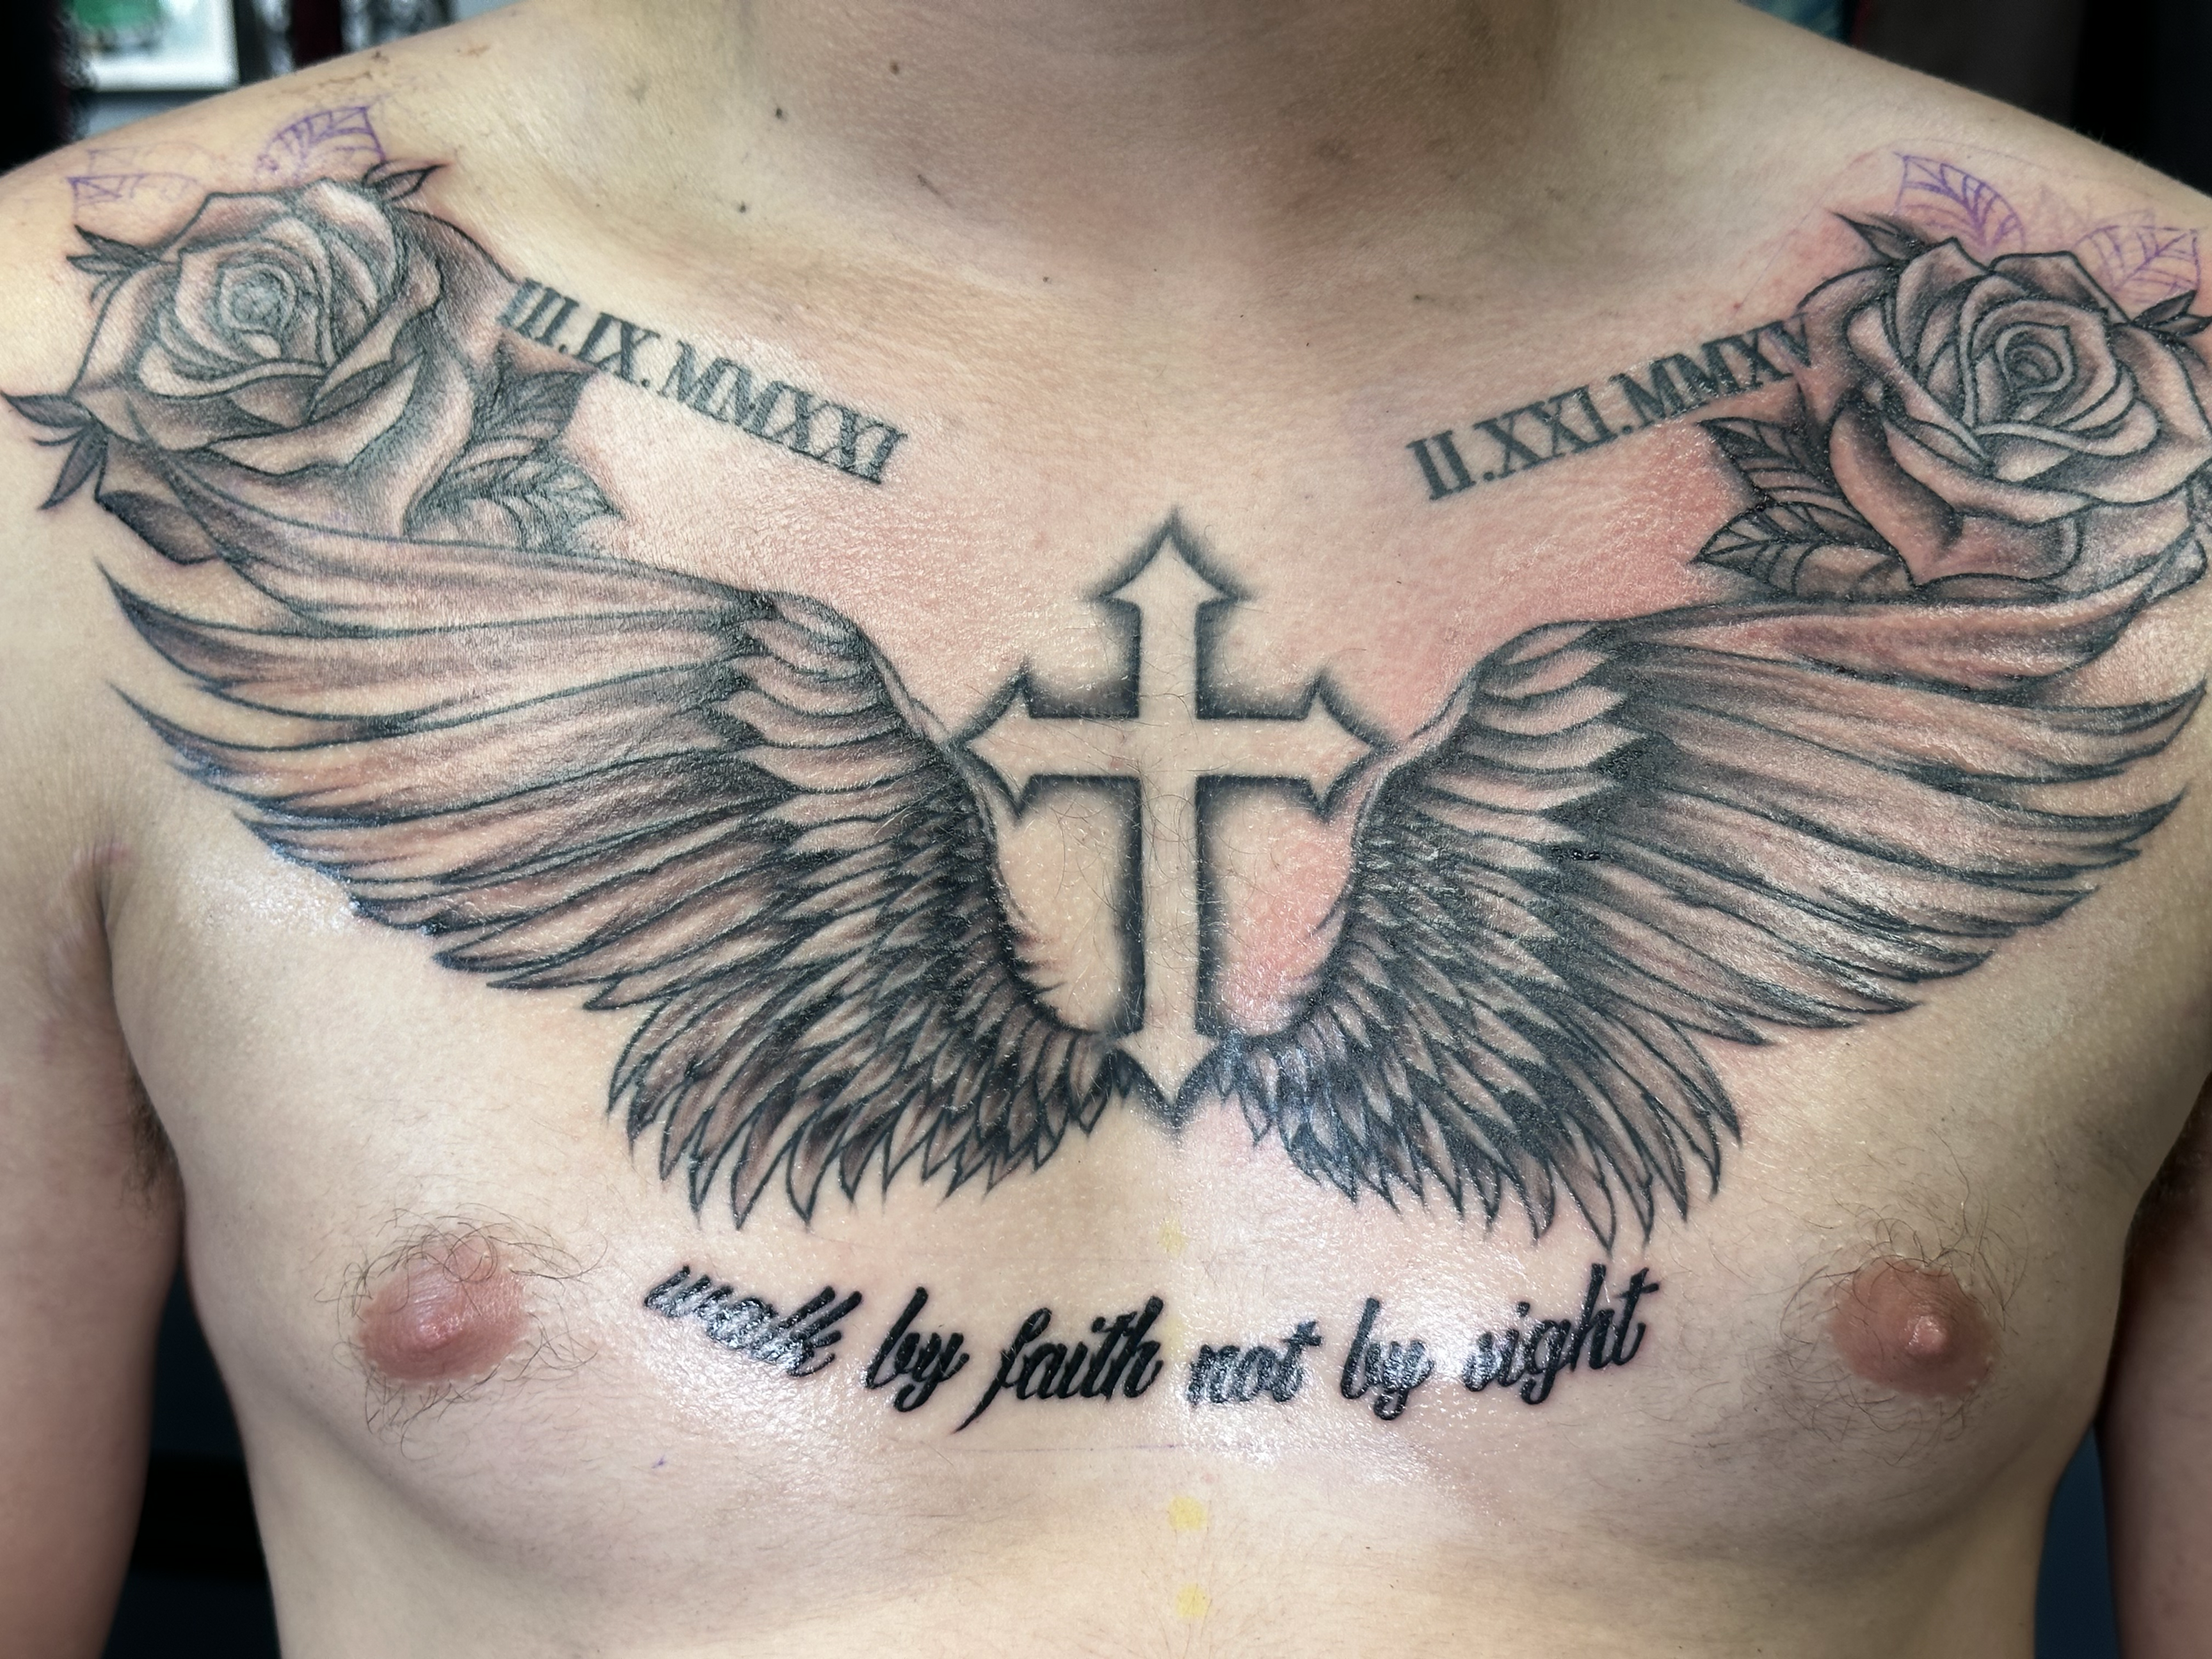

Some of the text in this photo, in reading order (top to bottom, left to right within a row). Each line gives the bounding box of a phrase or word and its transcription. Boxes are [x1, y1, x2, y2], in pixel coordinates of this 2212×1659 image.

[1406, 311, 1811, 500] II.XXI.MMXV
[864, 1286, 970, 1412] by
[953, 1295, 1164, 1433] faith
[1187, 1322, 1321, 1404] not
[1340, 1298, 1433, 1420] by
[1464, 1263, 1659, 1405] sight
